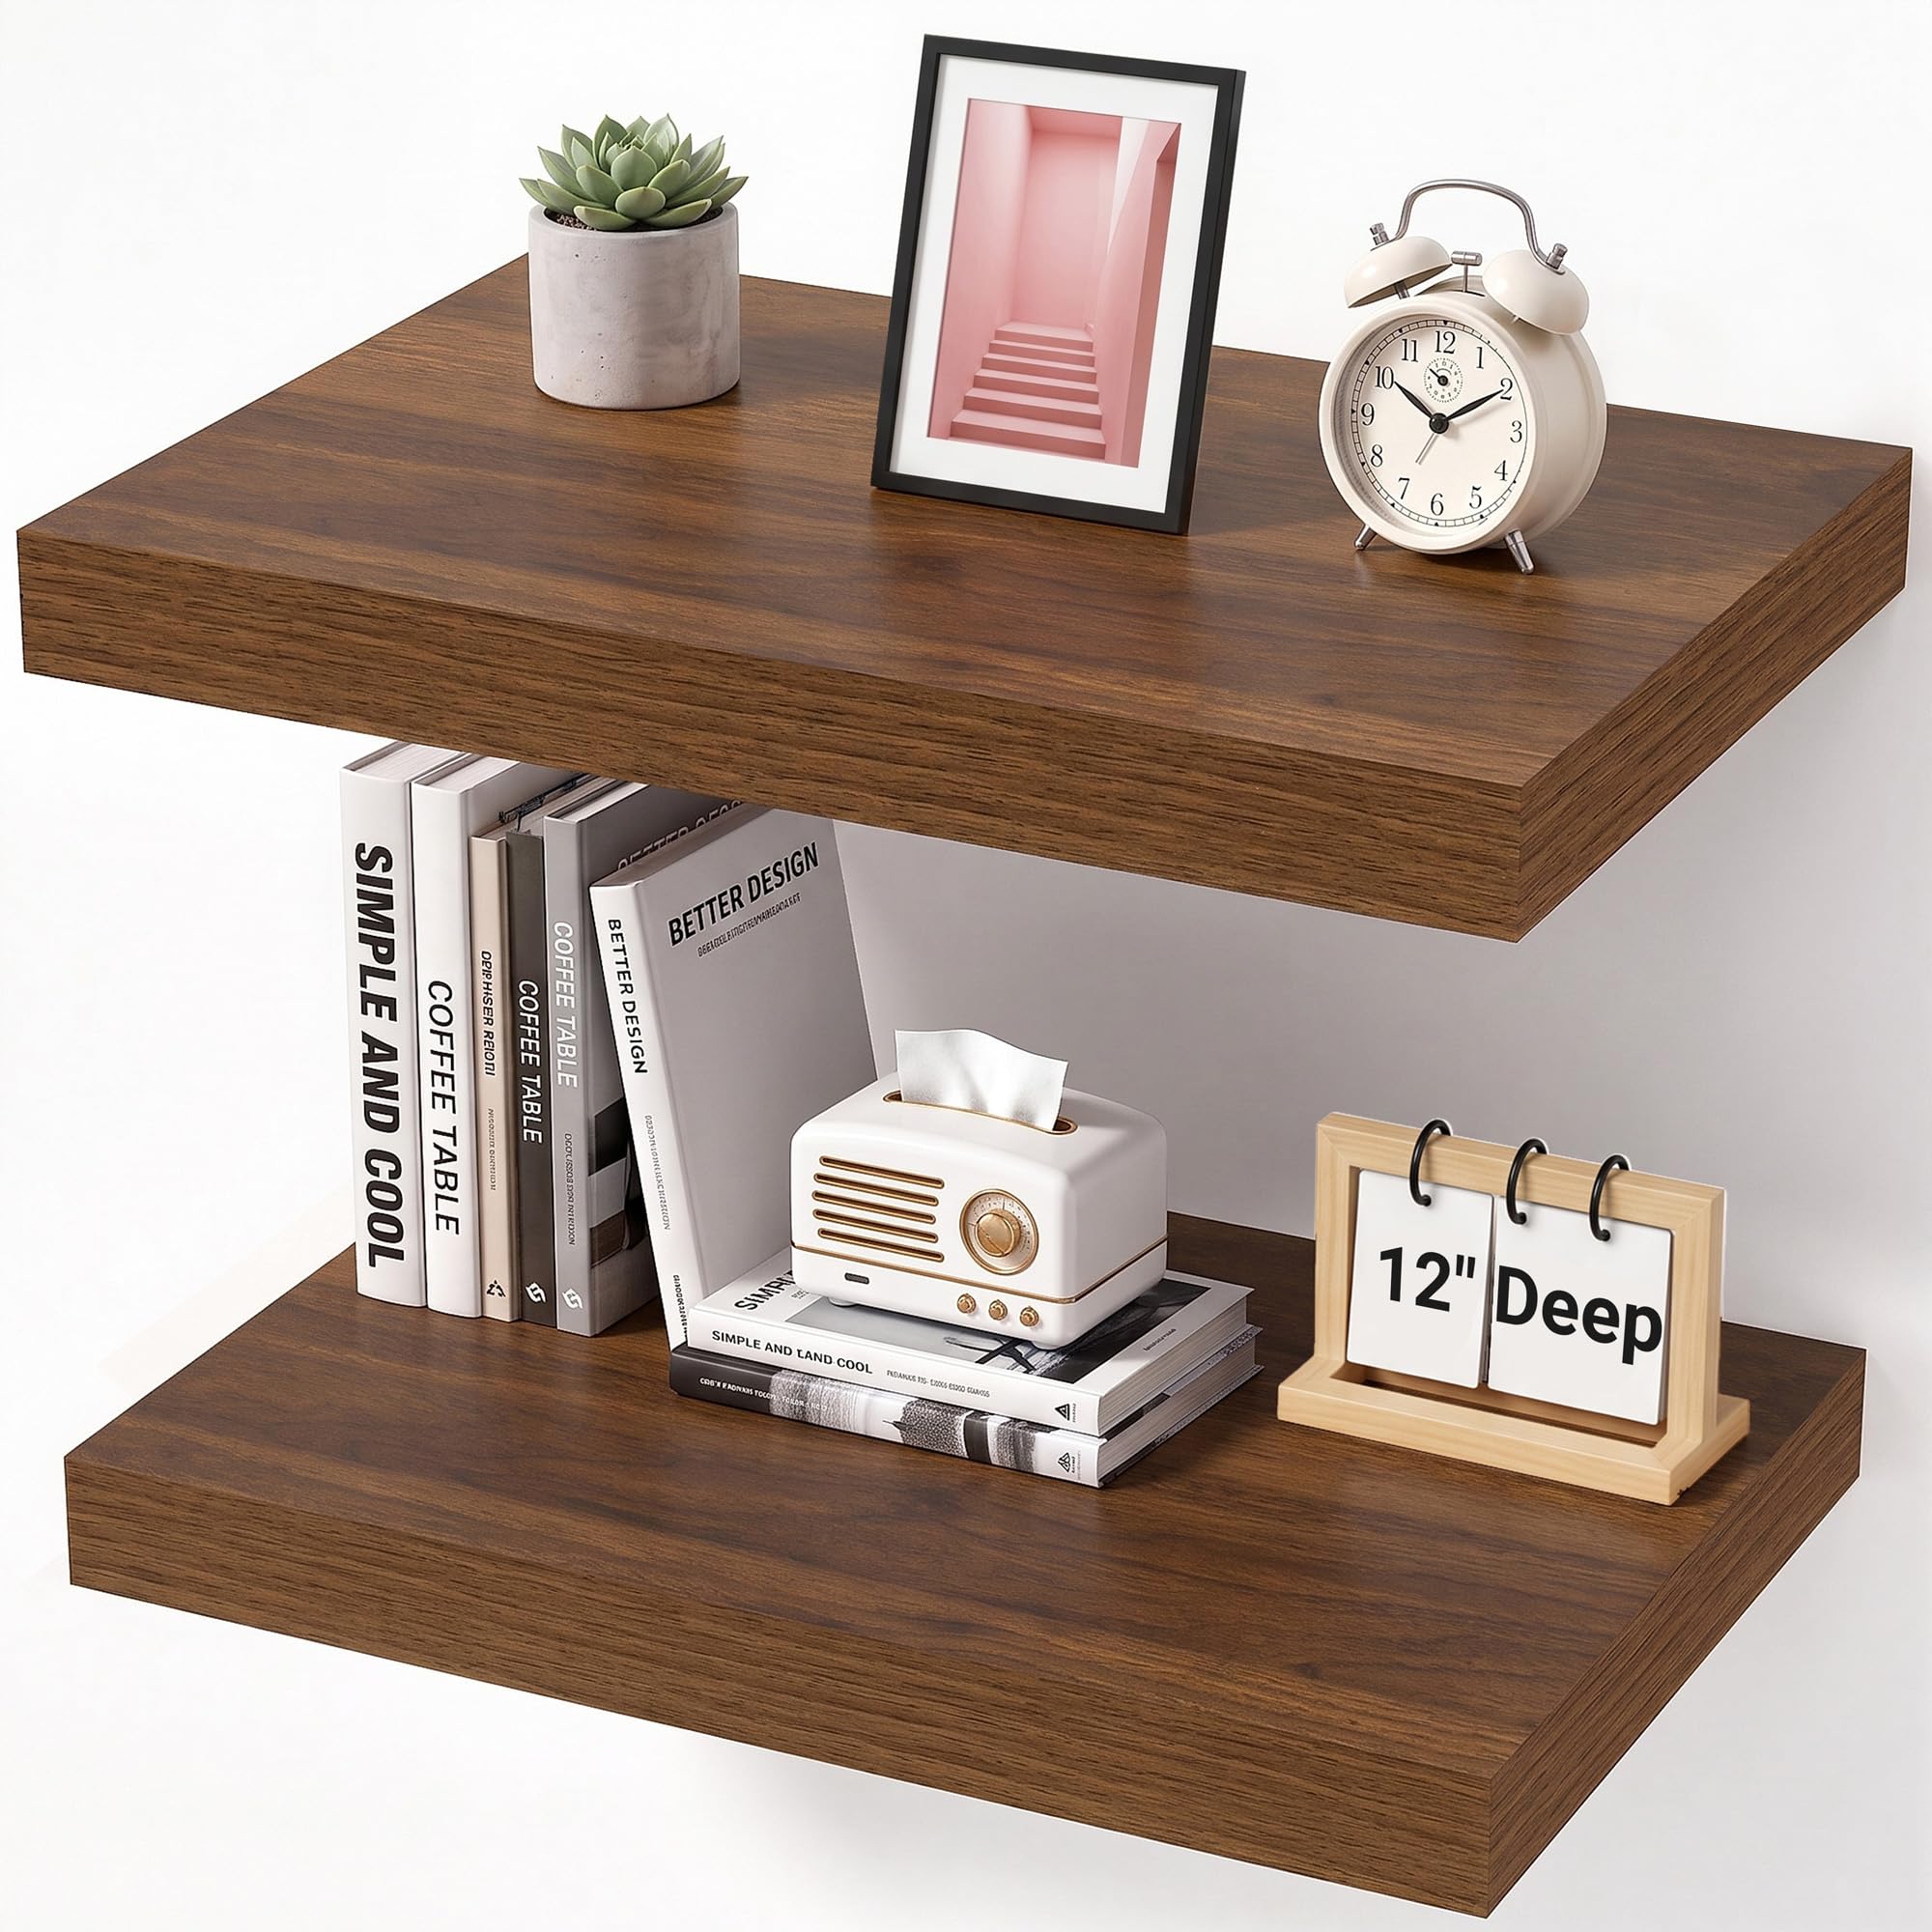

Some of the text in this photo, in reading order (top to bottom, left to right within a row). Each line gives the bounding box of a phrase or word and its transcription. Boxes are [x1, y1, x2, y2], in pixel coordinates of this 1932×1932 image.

[1402, 339, 1419, 362] 11
[1435, 330, 1456, 354] 12
[1476, 347, 1485, 369] 1
[1375, 366, 1395, 389] 10
[1499, 378, 1514, 401] 2
[1361, 403, 1375, 426] 9
[1510, 420, 1522, 442] 3
[1370, 444, 1383, 468] 8
[1493, 460, 1509, 481] 4
[1398, 477, 1410, 499] 7
[1469, 486, 1484, 509] 5
[1430, 493, 1444, 516] 6
[668, 884, 745, 947] BETTER
[747, 841, 819, 904] DESIGN
[554, 921, 578, 1088] COFFEE TABLE
[608, 919, 648, 1073] BETTER DESIGN
[355, 842, 405, 1267] SIMPLE AND COOL
[519, 980, 543, 1144] COFFEE TABLE
[428, 980, 460, 1236] COFFEE TABLE
[1379, 1246, 1662, 1366] 12" Deep
[712, 1330, 761, 1350] SIMPLE
[764, 1343, 792, 1357] AND
[837, 1357, 873, 1374] COOL
